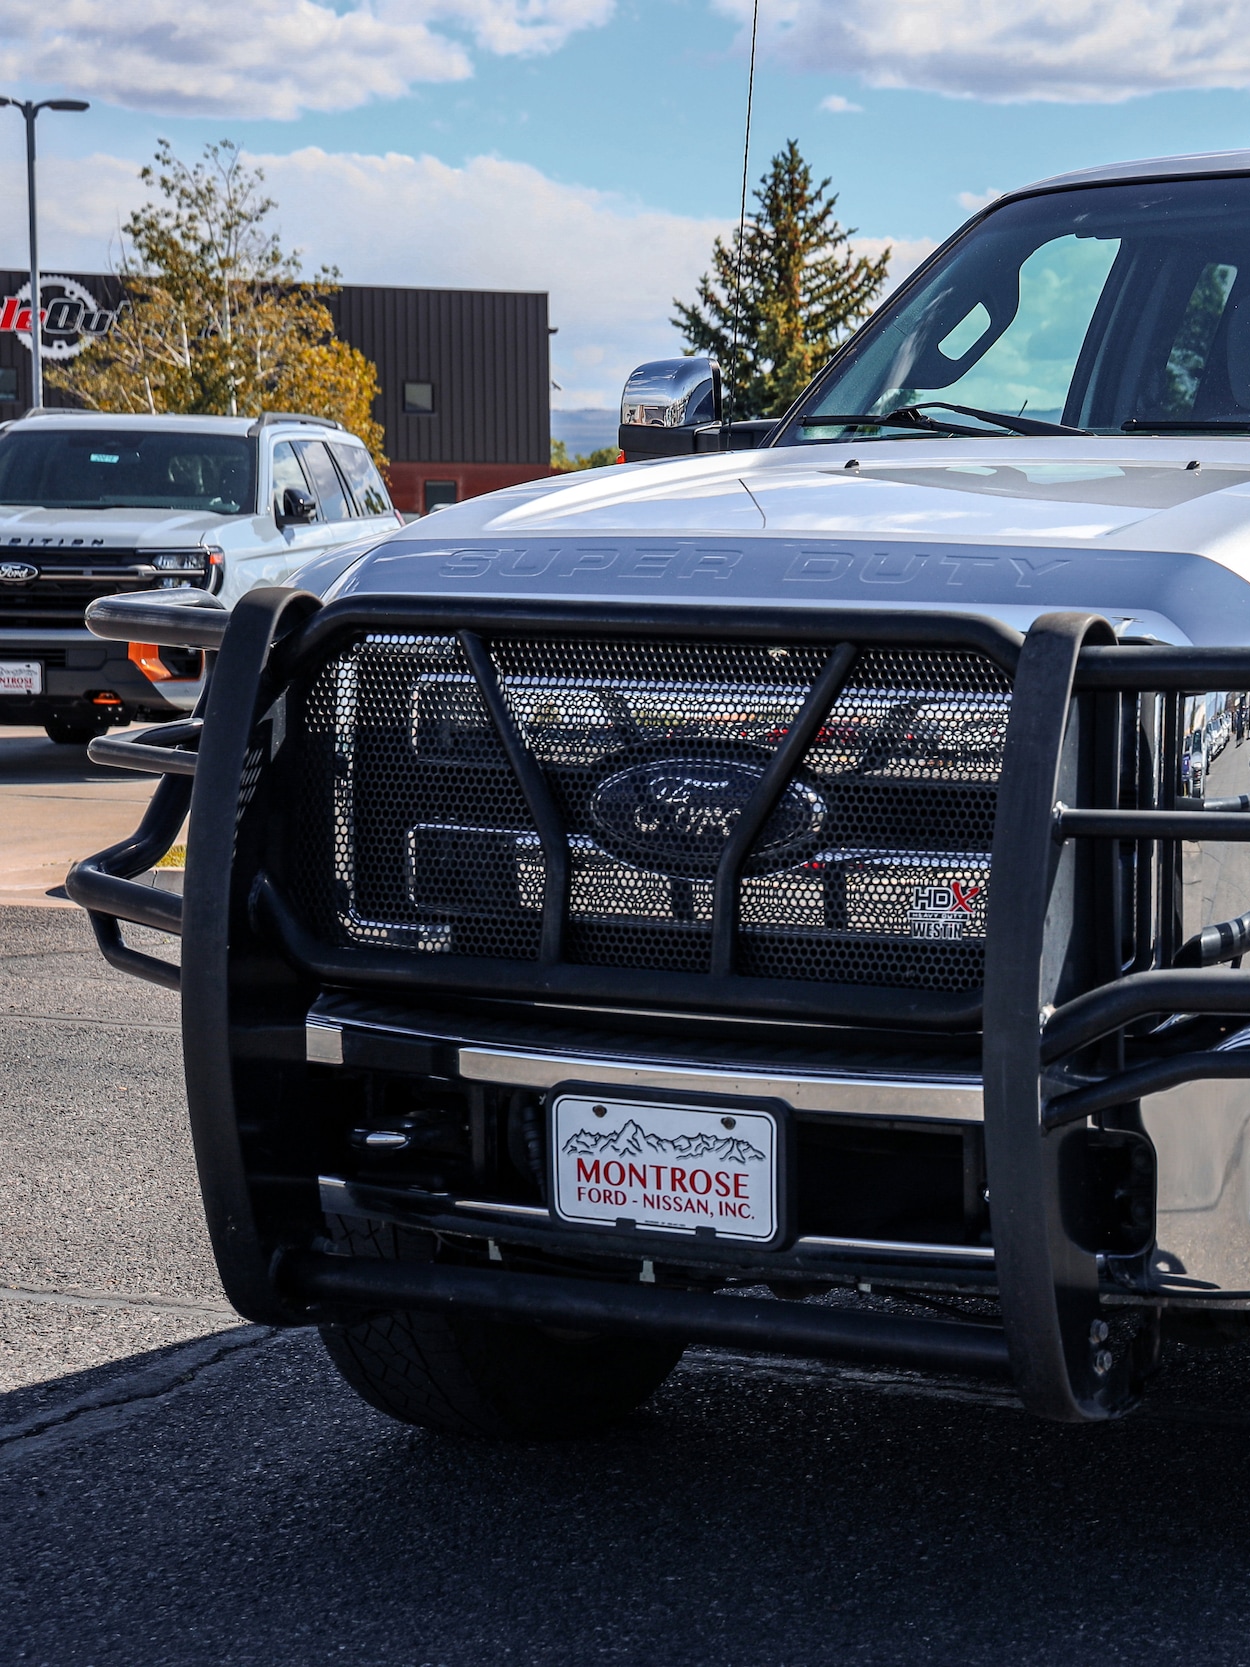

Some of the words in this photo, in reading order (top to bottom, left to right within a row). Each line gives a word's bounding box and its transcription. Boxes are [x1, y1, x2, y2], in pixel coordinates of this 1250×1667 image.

[0, 296, 133, 336] leOu
[0, 537, 104, 546] DITION
[438, 548, 744, 579] SUPER
[782, 551, 1072, 588] DUTY
[912, 881, 981, 913] HDX
[576, 1157, 751, 1200] MONTROSE
[577, 1186, 627, 1206] FORD
[643, 1193, 714, 1218] NISSAN,
[718, 1201, 755, 1220] INC.
